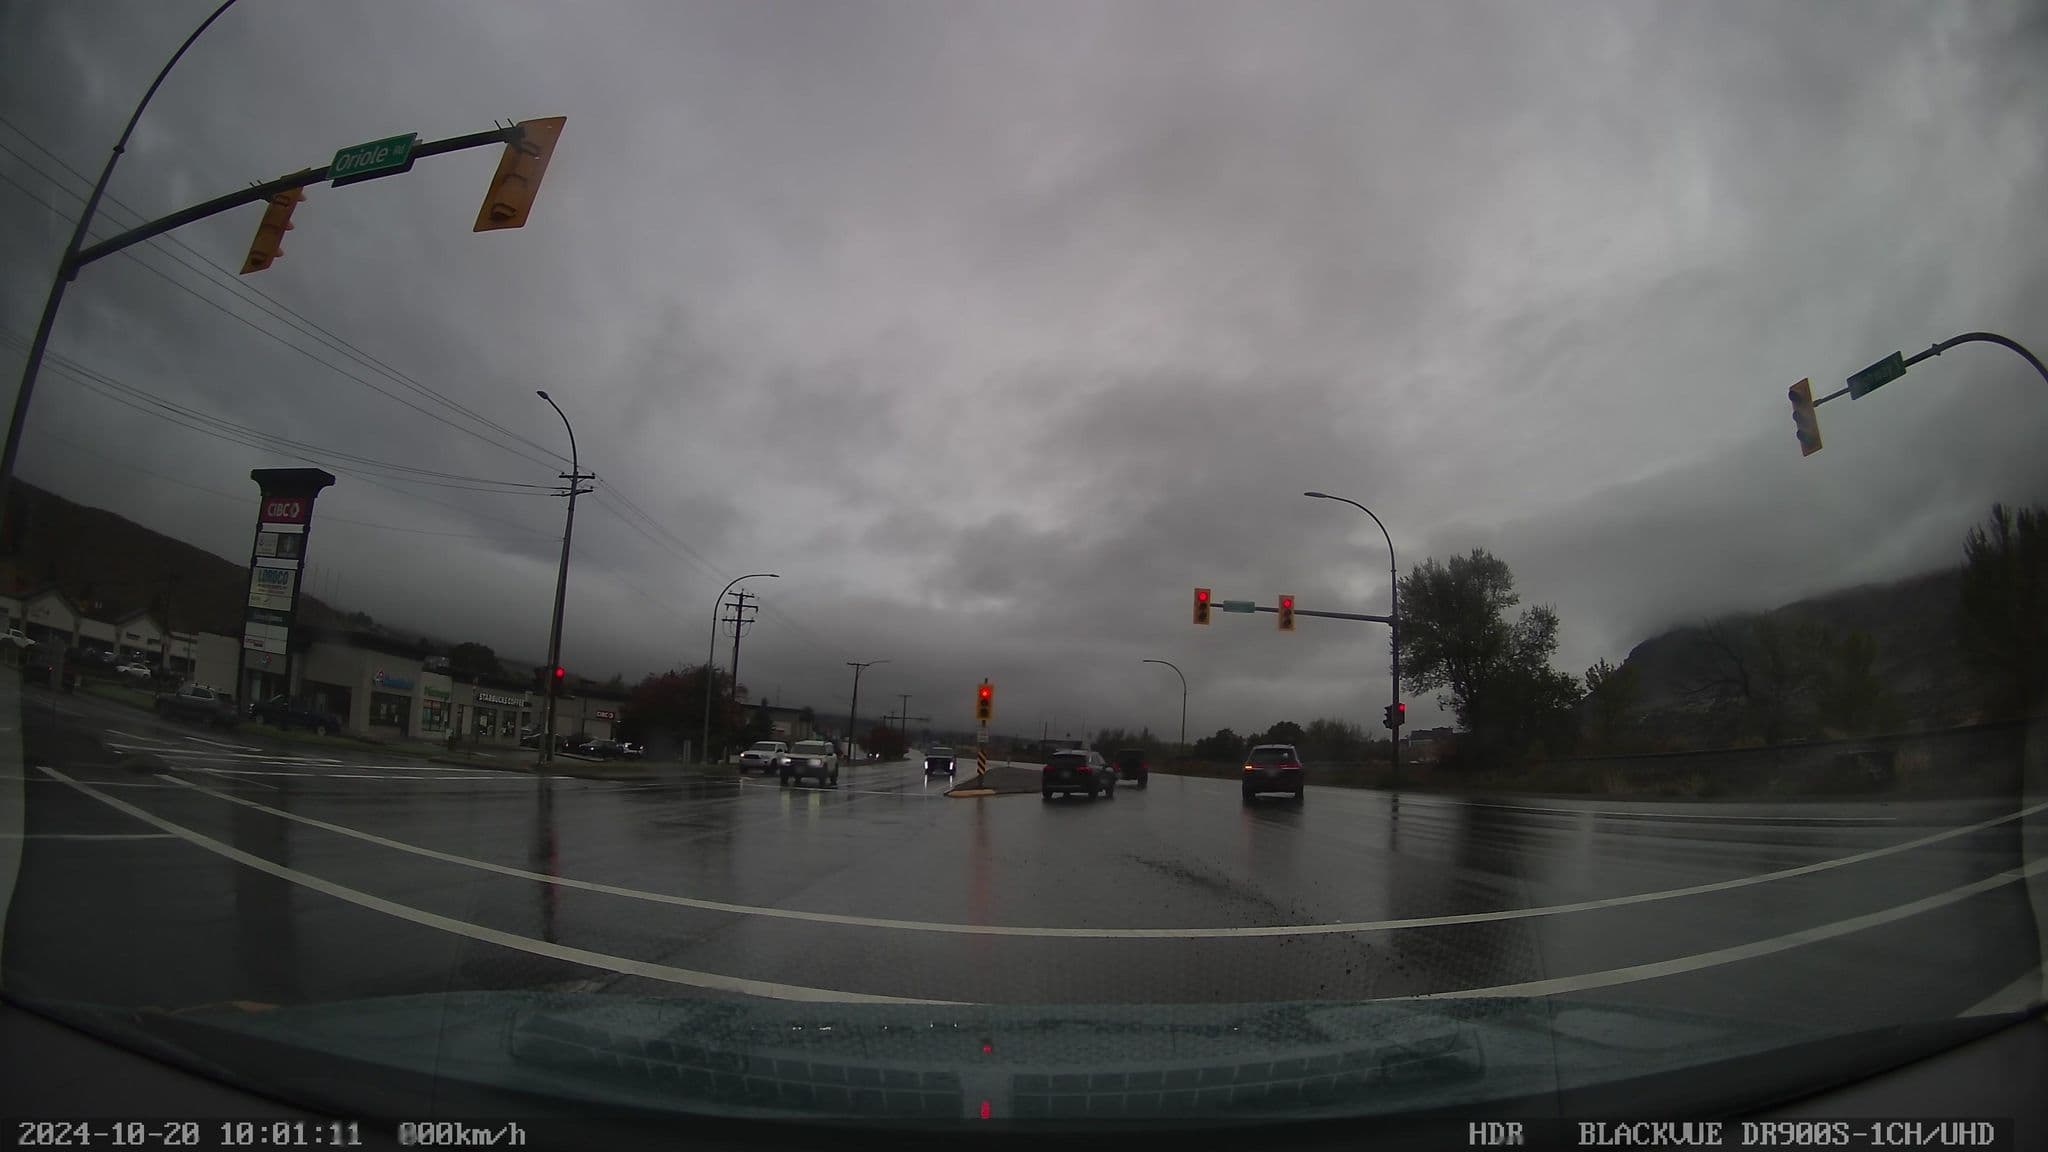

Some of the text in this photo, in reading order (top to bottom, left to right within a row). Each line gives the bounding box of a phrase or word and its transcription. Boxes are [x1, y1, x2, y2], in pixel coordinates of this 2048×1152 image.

[336, 146, 388, 171] Oriole
[267, 503, 290, 517] CIBC
[478, 692, 525, 708] STARBUCKS COFFEE
